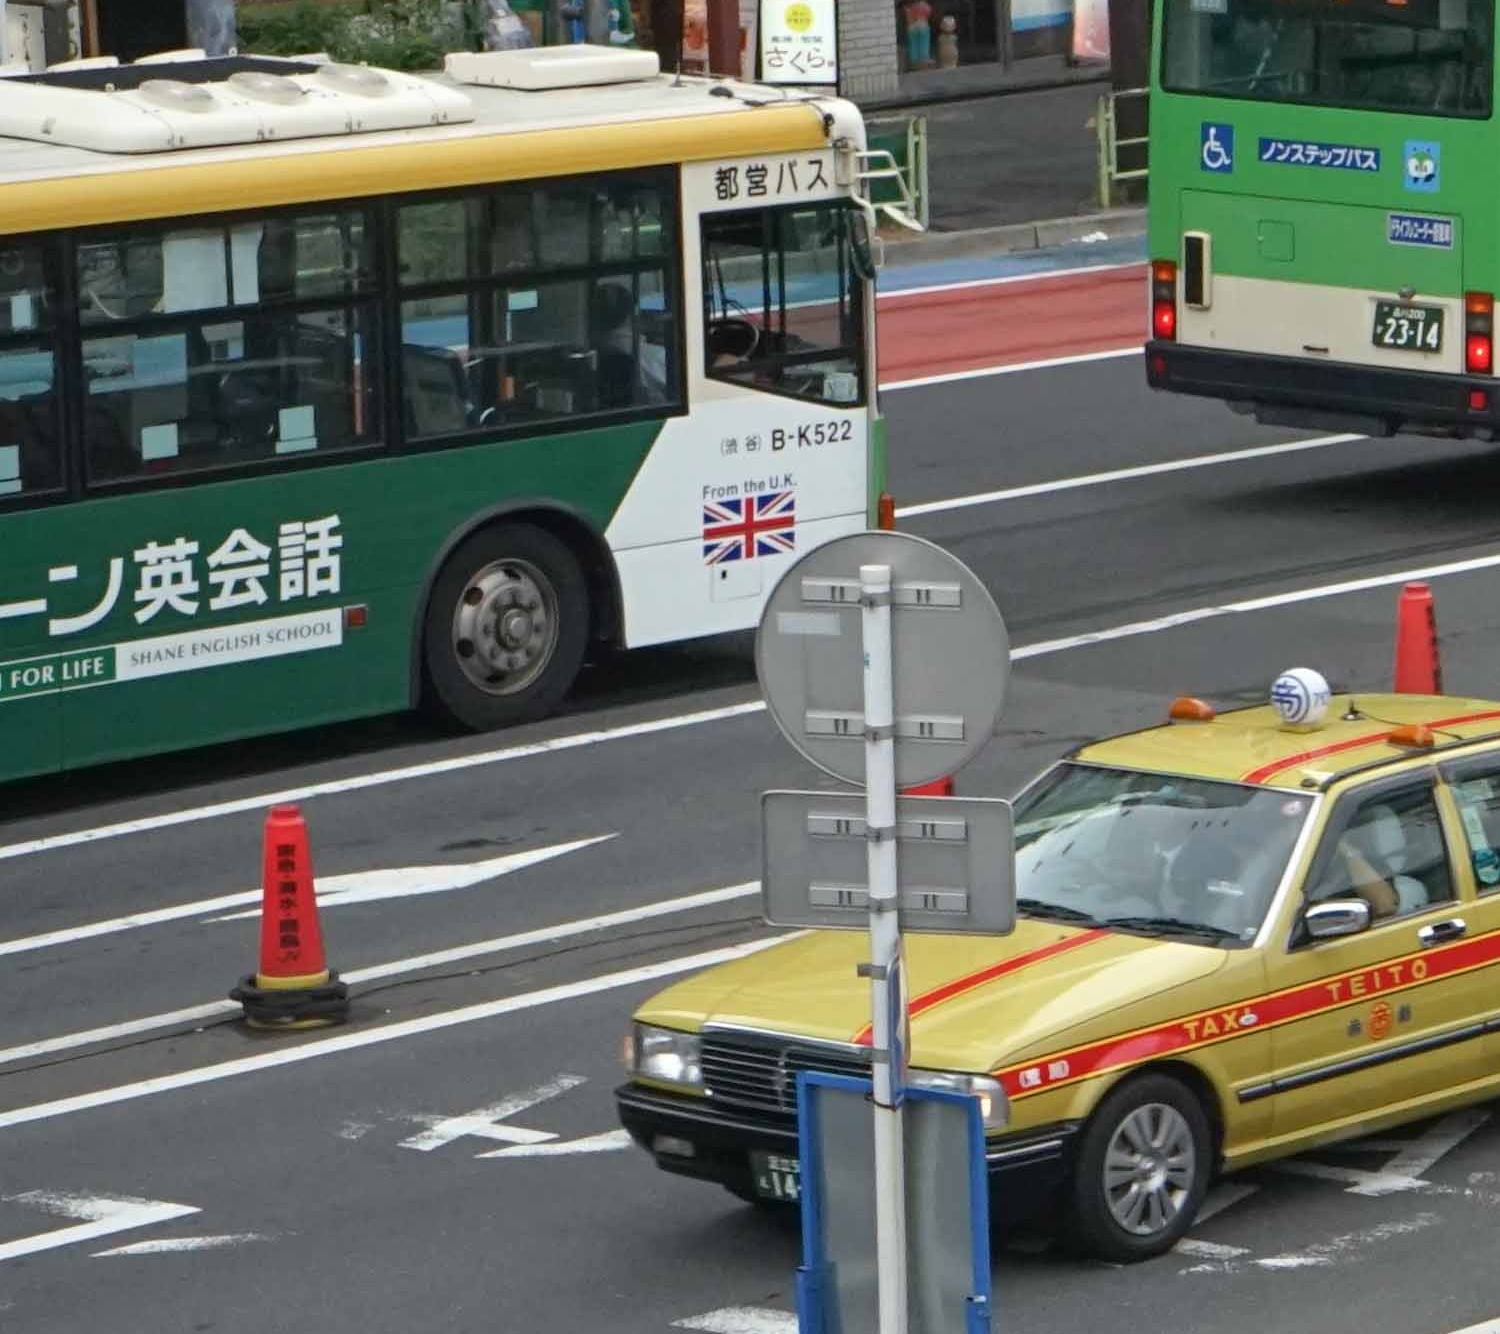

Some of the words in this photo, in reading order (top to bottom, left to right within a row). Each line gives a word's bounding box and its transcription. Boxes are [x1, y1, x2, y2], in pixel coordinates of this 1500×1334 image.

[765, 45, 825, 74] さくら
[1262, 142, 1378, 170] ノンステップバス
[714, 158, 829, 201] 都営バス
[1383, 317, 1439, 348] 23-14
[771, 419, 853, 452] B-K522
[702, 484, 739, 500] From
[743, 478, 766, 494] the
[769, 473, 798, 490] U.K.
[131, 644, 186, 667] SHANE
[191, 634, 262, 658] ENGLISH
[265, 619, 334, 644] SCHOOL
[10, 663, 55, 689] FOR
[62, 656, 105, 681] LIFE
[1327, 959, 1428, 1001] TEITO
